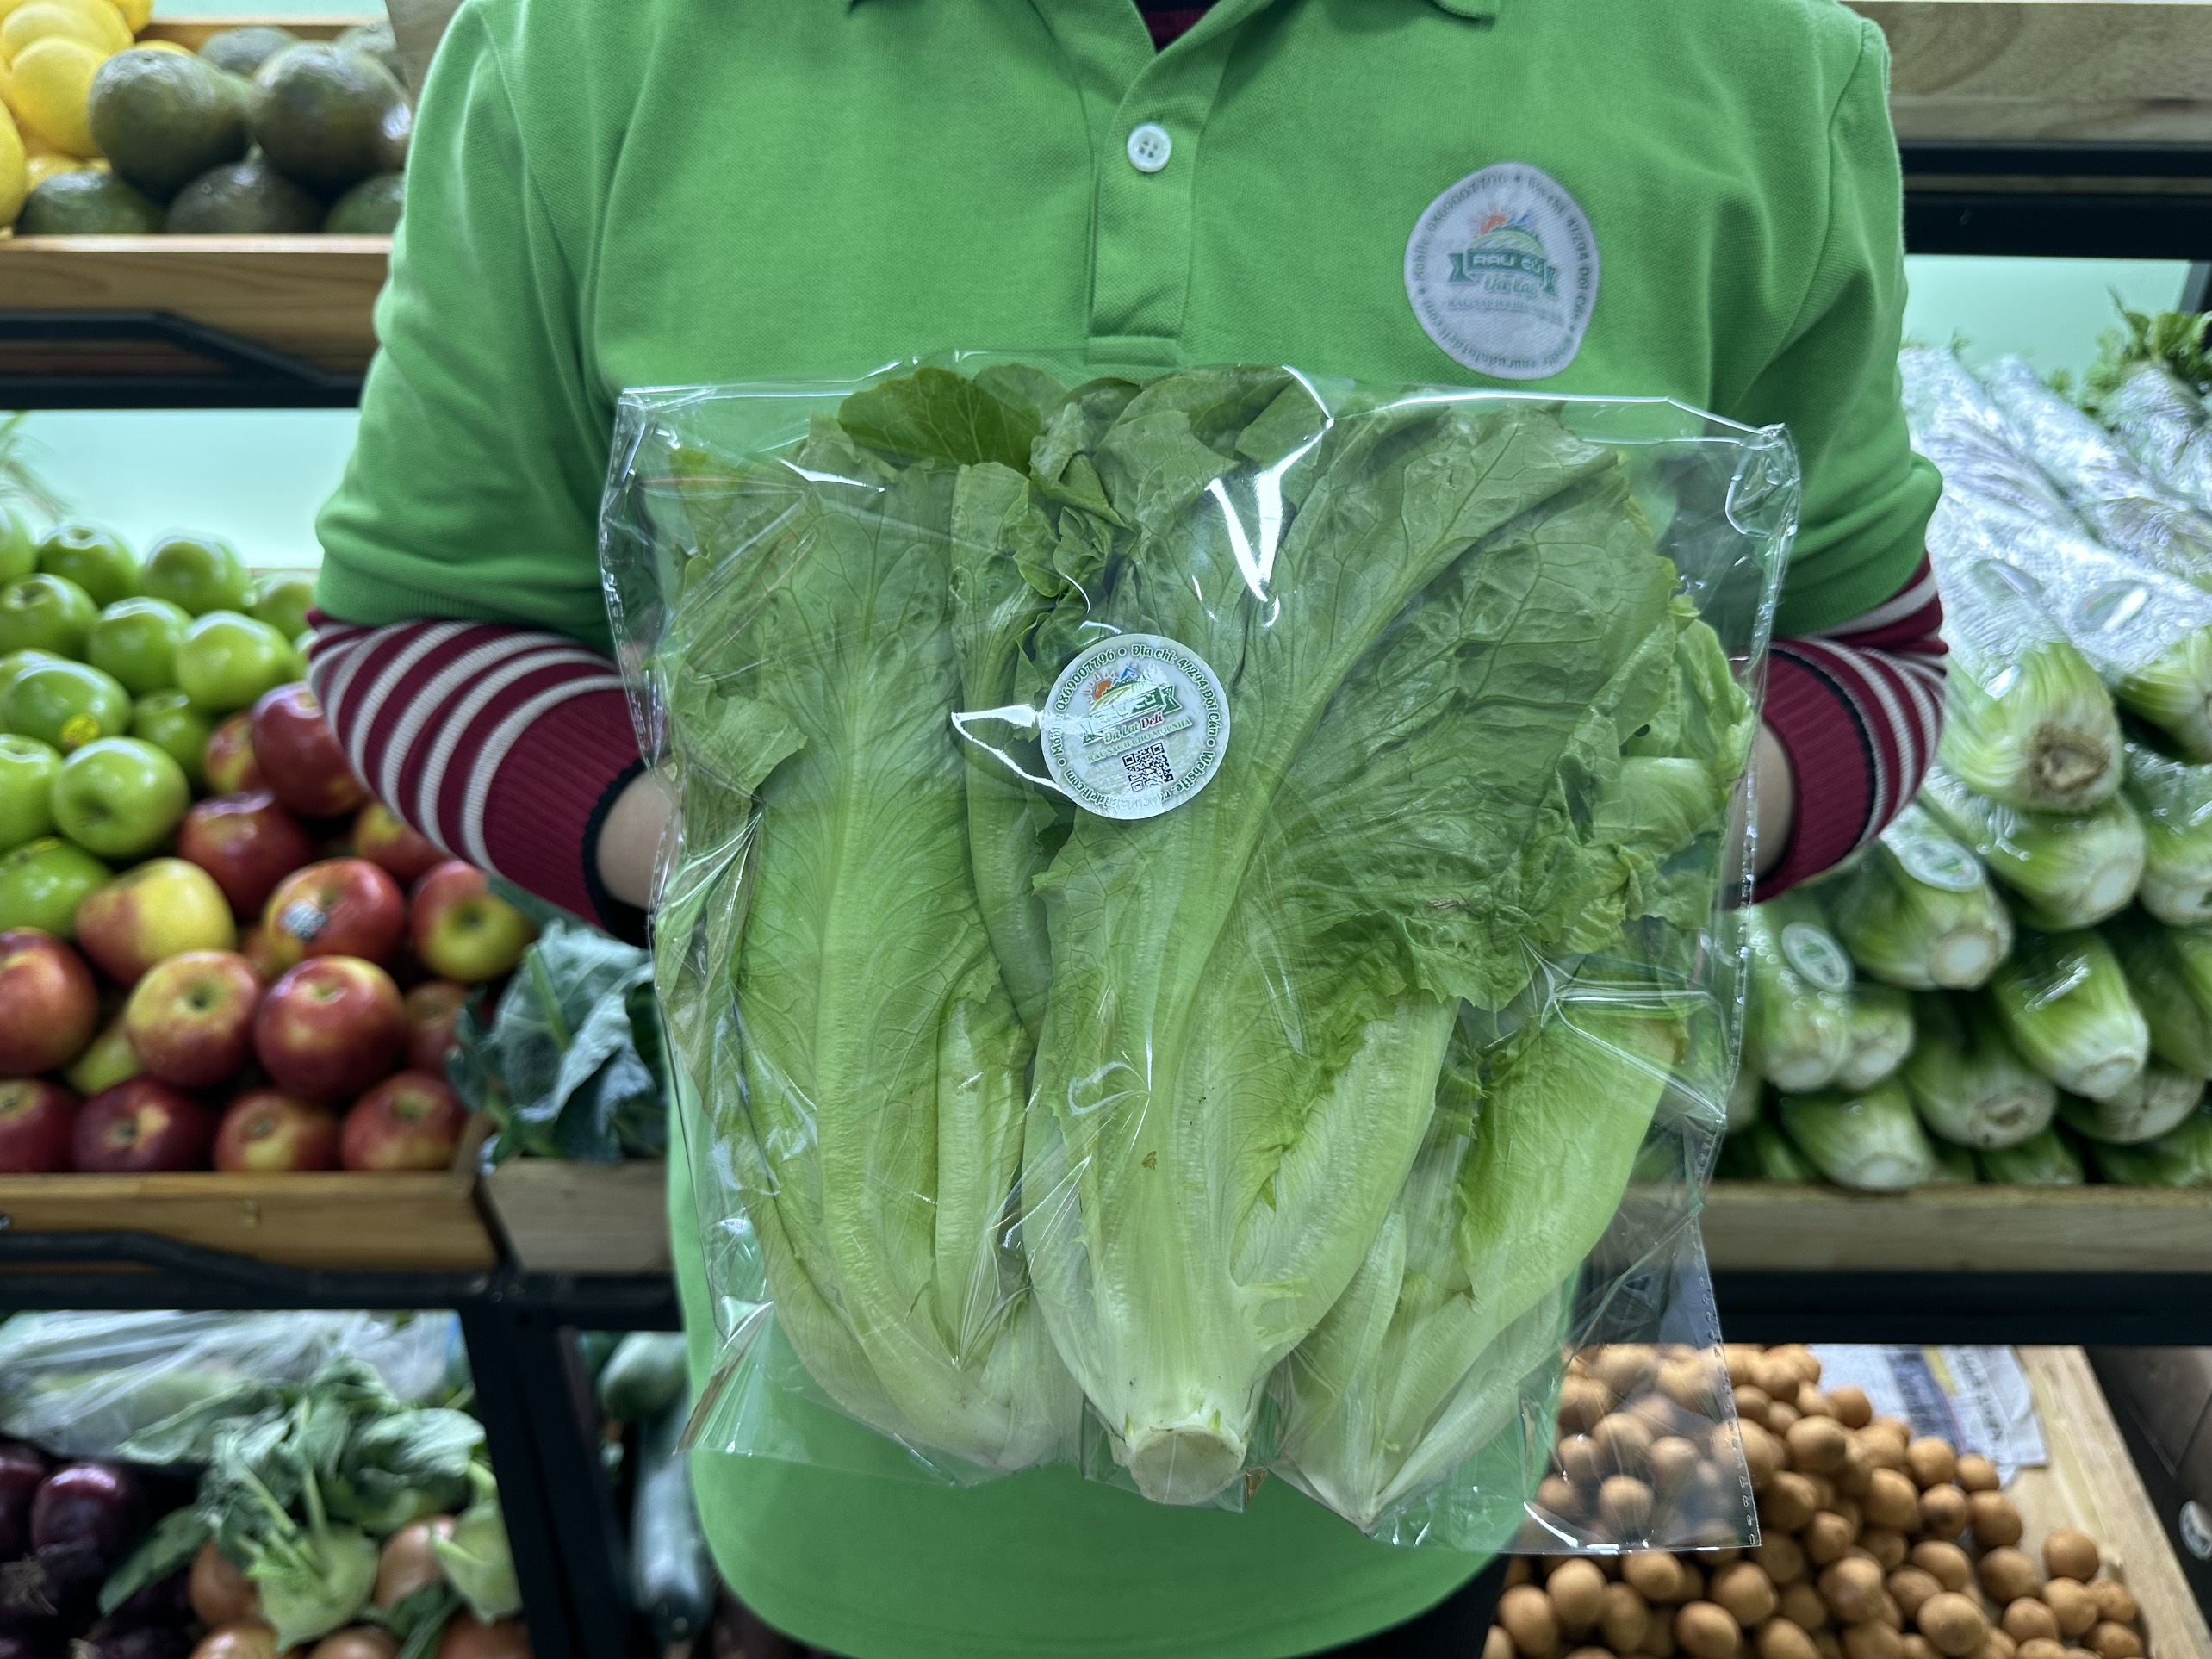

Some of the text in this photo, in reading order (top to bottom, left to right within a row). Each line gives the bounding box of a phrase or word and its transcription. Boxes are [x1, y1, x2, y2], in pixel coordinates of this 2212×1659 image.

[1472, 253, 1517, 268] RAU
[1055, 649, 1115, 711] 0869007796
[1132, 644, 1153, 658] Địa
[1177, 659, 1209, 690] 4/294
[1141, 711, 1163, 728] Deli
[1172, 752, 1214, 794] Website:
